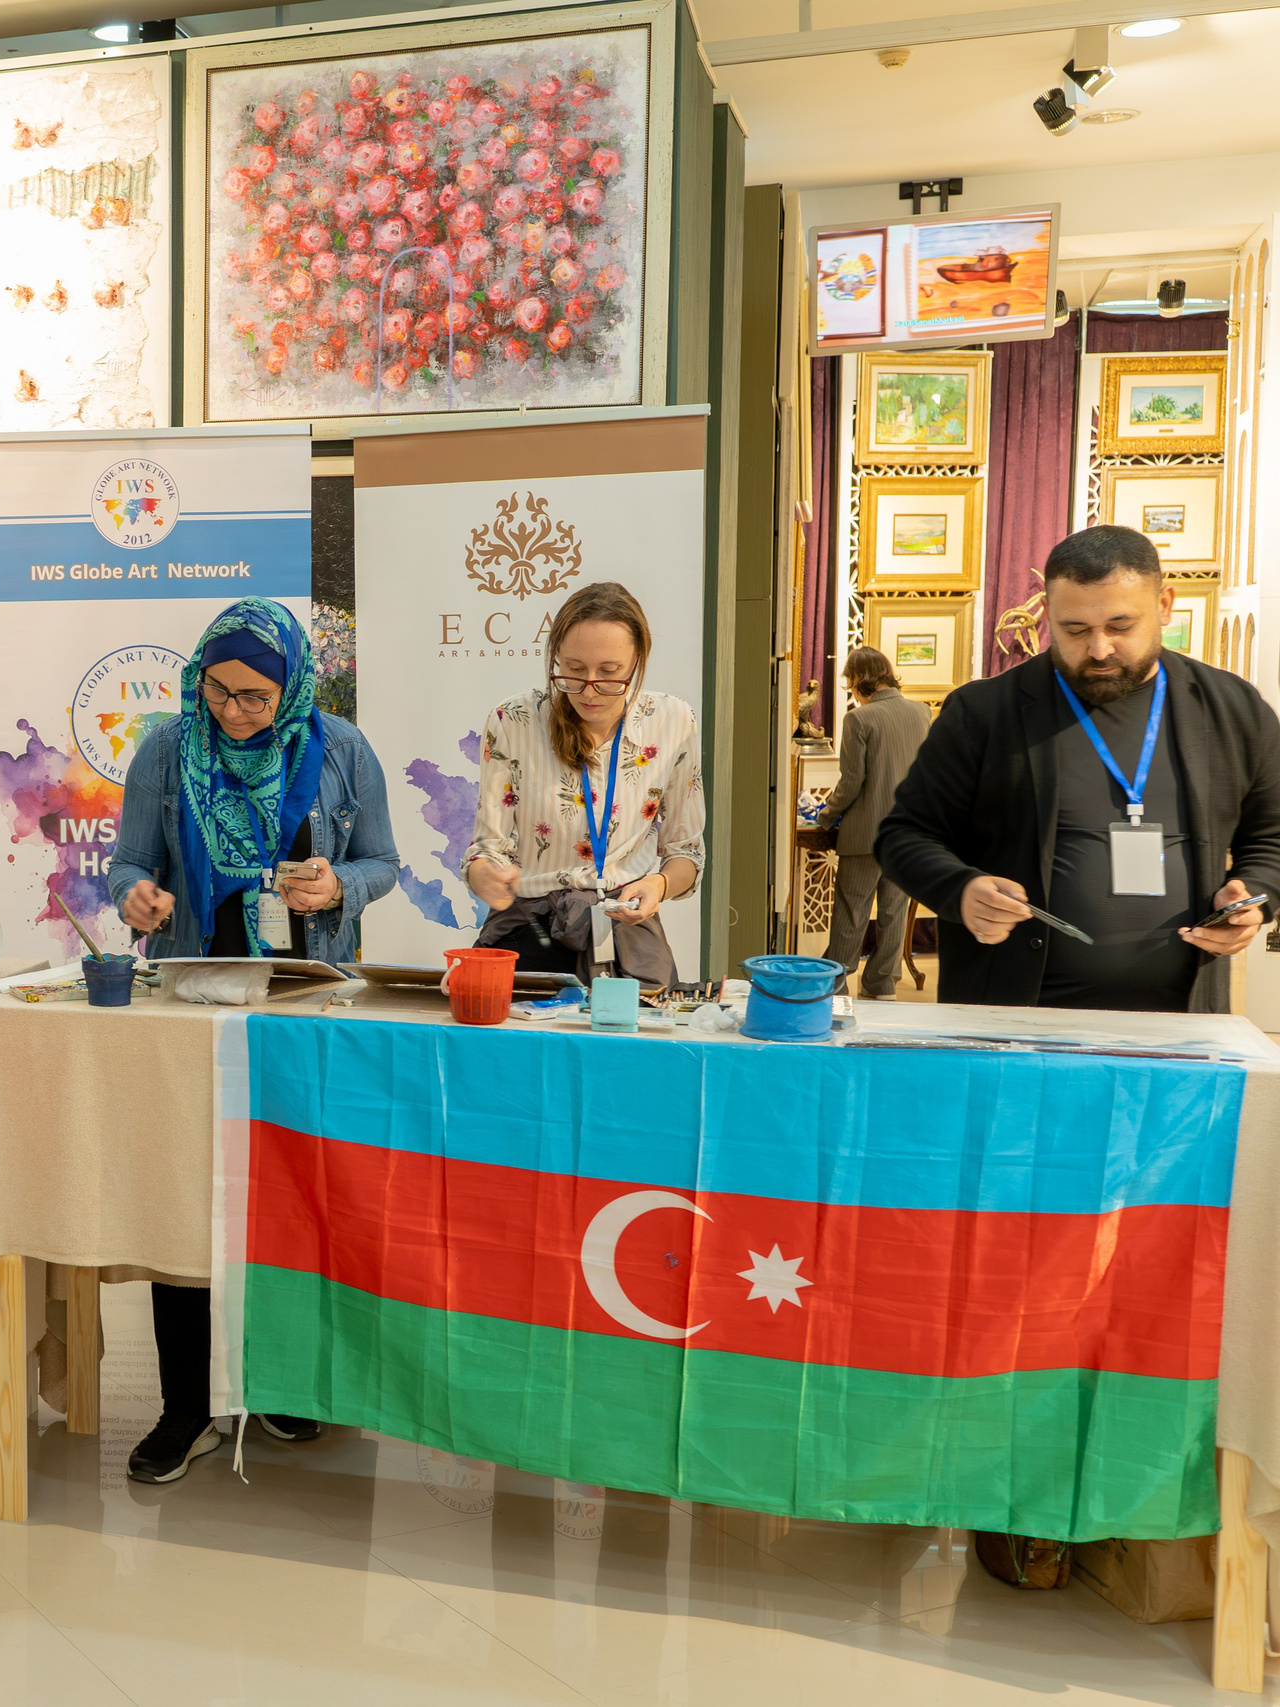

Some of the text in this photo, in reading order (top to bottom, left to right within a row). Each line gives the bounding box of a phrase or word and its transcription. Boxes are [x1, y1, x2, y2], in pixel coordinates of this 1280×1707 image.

[95, 462, 176, 501] GLOBE ART NETWORK
[117, 479, 155, 494] IWS
[122, 533, 152, 546] 2012
[30, 560, 252, 581] IWS Globe Art Network
[438, 611, 556, 645] ECA
[439, 649, 542, 658] ART & HOBB
[78, 651, 184, 708] GLOBE ART NET
[120, 681, 172, 700] IWS
[82, 738, 125, 779] IWS ART
[59, 817, 117, 844] IWS
